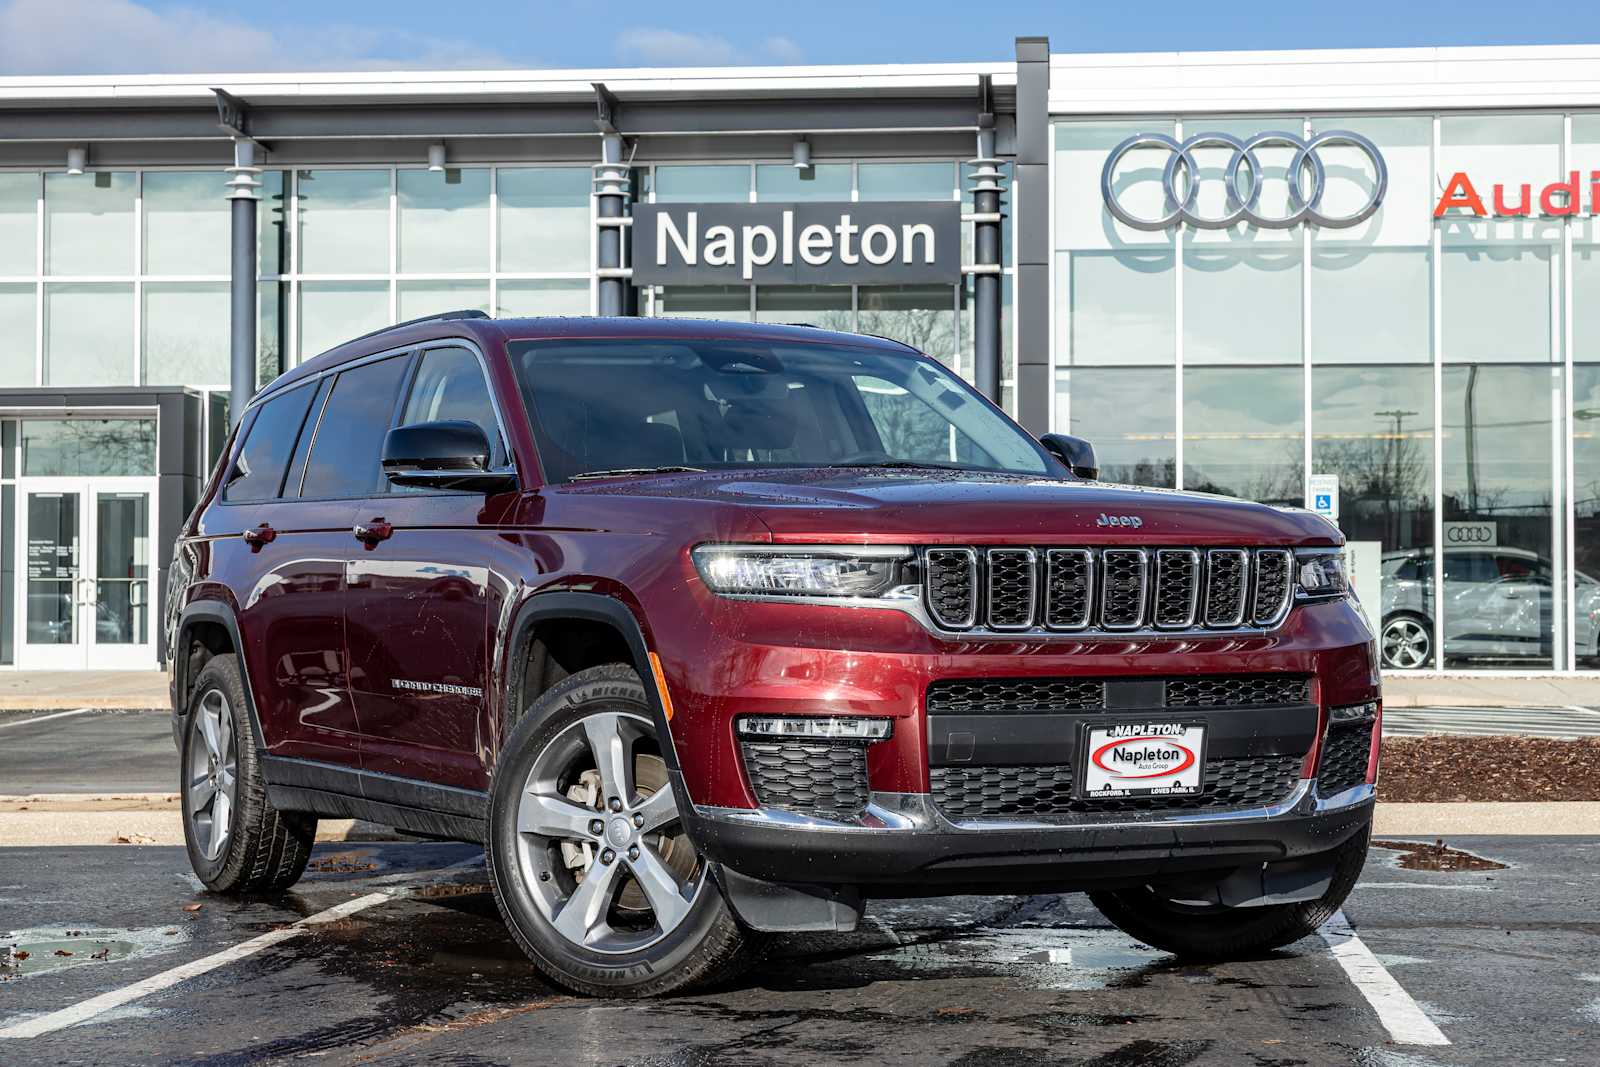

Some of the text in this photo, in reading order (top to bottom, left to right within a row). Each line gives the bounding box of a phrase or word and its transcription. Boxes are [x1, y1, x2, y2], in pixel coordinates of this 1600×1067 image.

[1433, 170, 1600, 217] Audi
[656, 210, 936, 280] Napleton
[1096, 512, 1143, 529] Jeep
[591, 686, 647, 700] MICHEL
[1115, 724, 1181, 736] NAPLETON
[1113, 747, 1179, 764] Napleton
